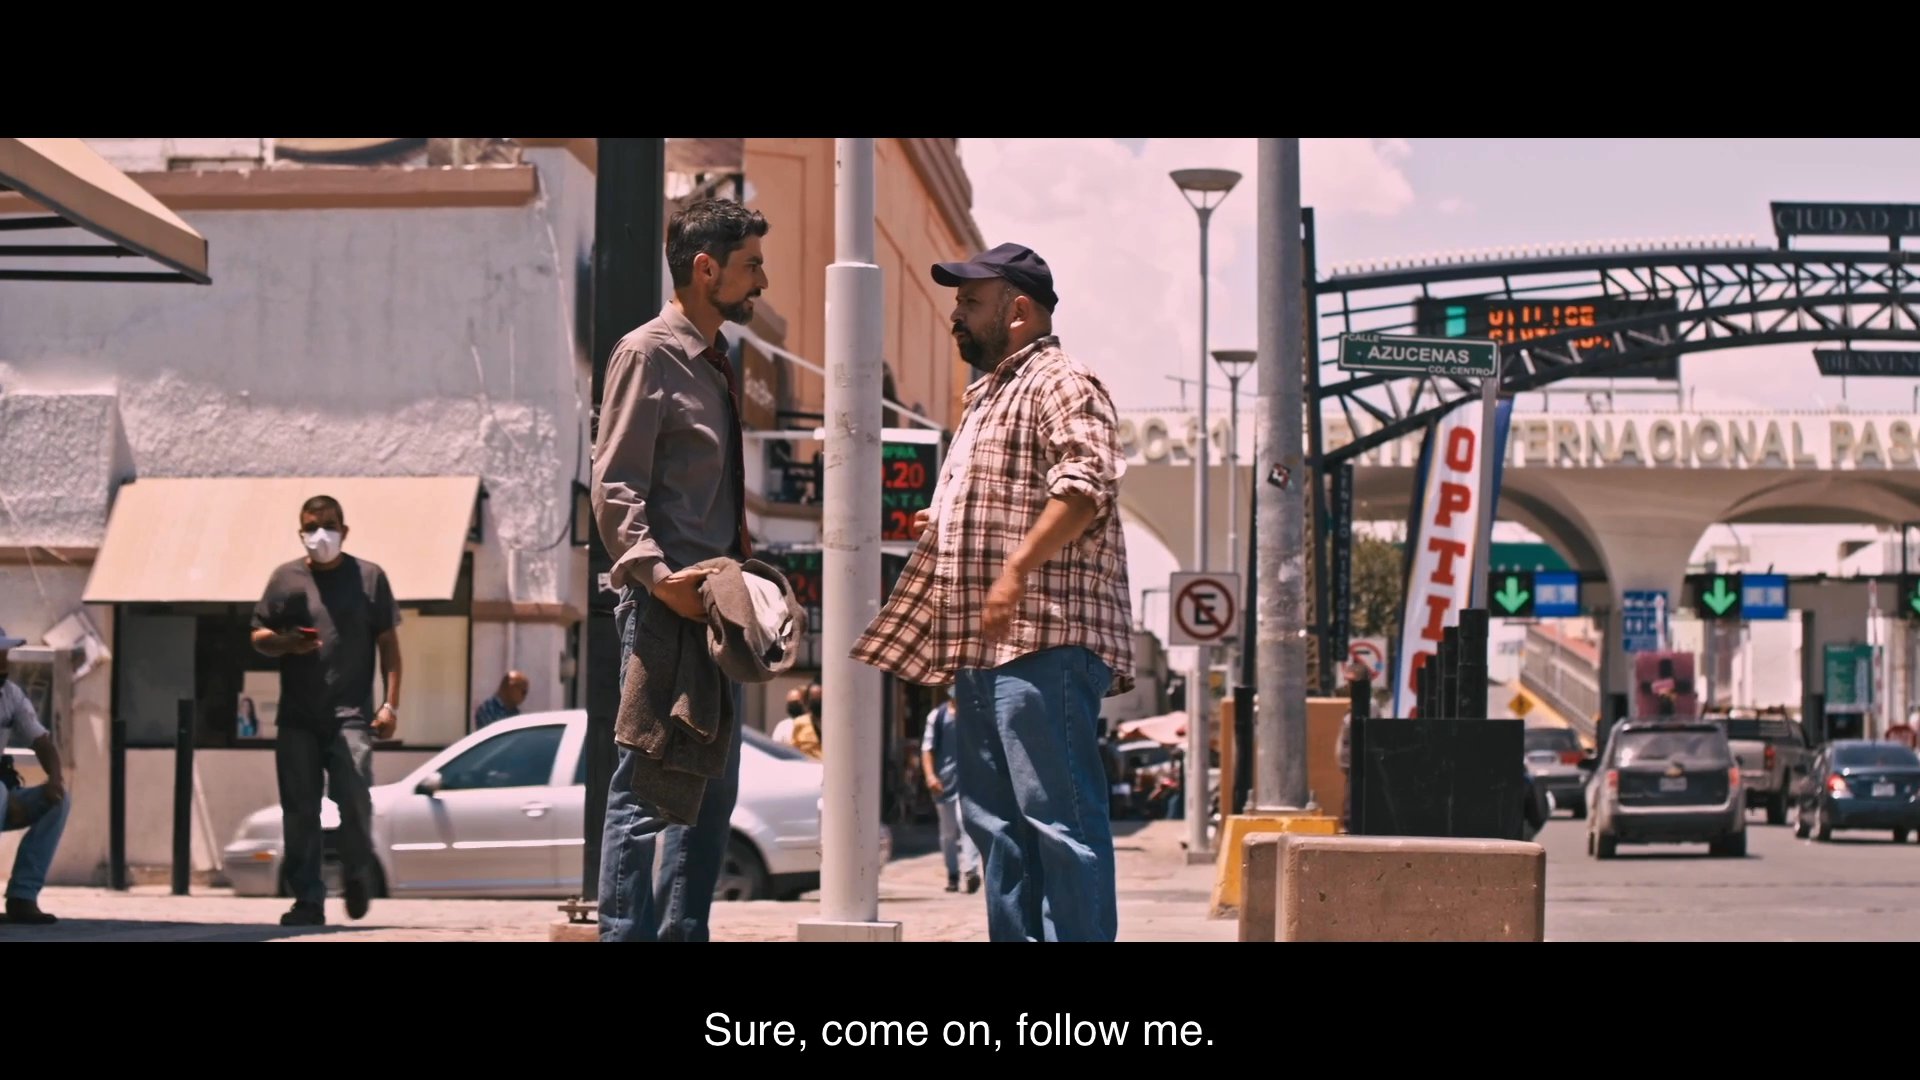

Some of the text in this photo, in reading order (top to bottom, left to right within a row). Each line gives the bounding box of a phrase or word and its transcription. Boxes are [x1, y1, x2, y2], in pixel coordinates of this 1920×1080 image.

[1776, 208, 1920, 231] CIUDAD J
[1348, 333, 1380, 343] CALLE
[1367, 345, 1470, 364] AZUCENAS
[1507, 419, 1920, 466] TERNACIONAL PAS
[883, 494, 927, 508] NTA
[1194, 593, 1216, 625] E
